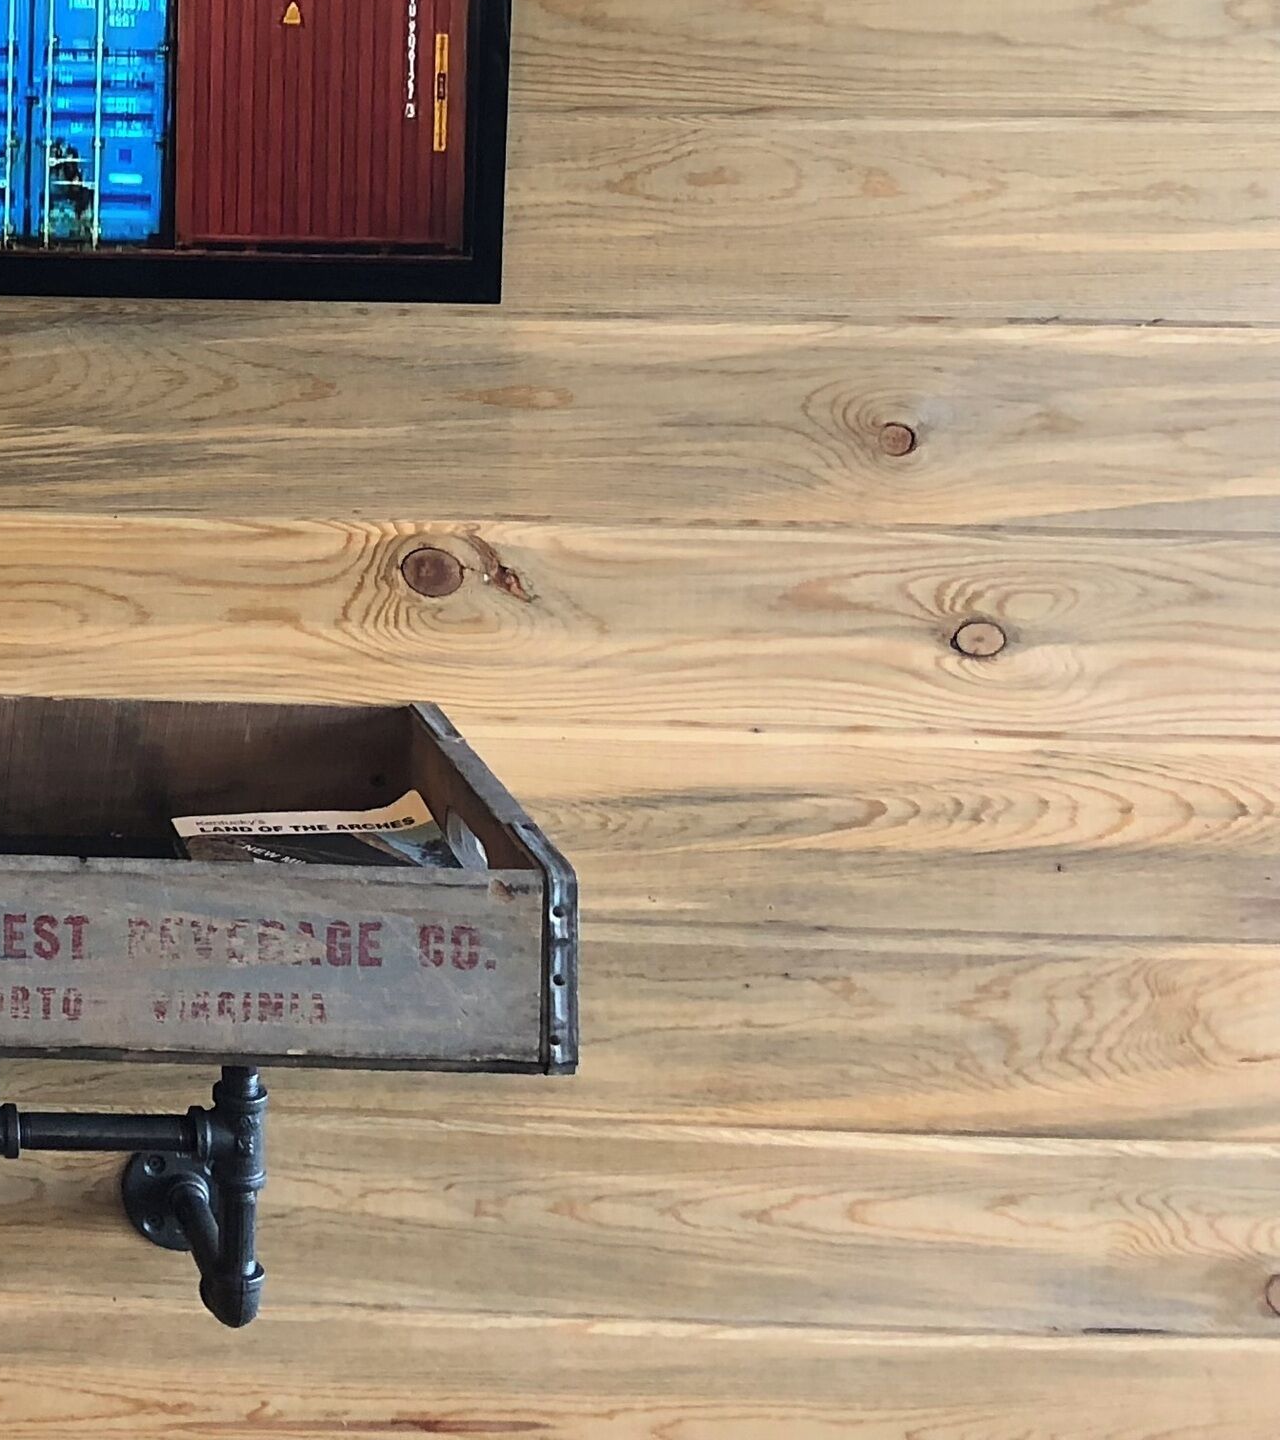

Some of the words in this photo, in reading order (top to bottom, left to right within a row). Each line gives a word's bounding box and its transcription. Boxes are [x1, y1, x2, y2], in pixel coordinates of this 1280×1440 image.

[199, 825, 254, 834] LAND
[258, 825, 285, 834] OF
[292, 823, 330, 833] THE
[336, 815, 416, 832] ARCHES
[241, 843, 281, 860] NEW
[417, 922, 498, 971] CO.
